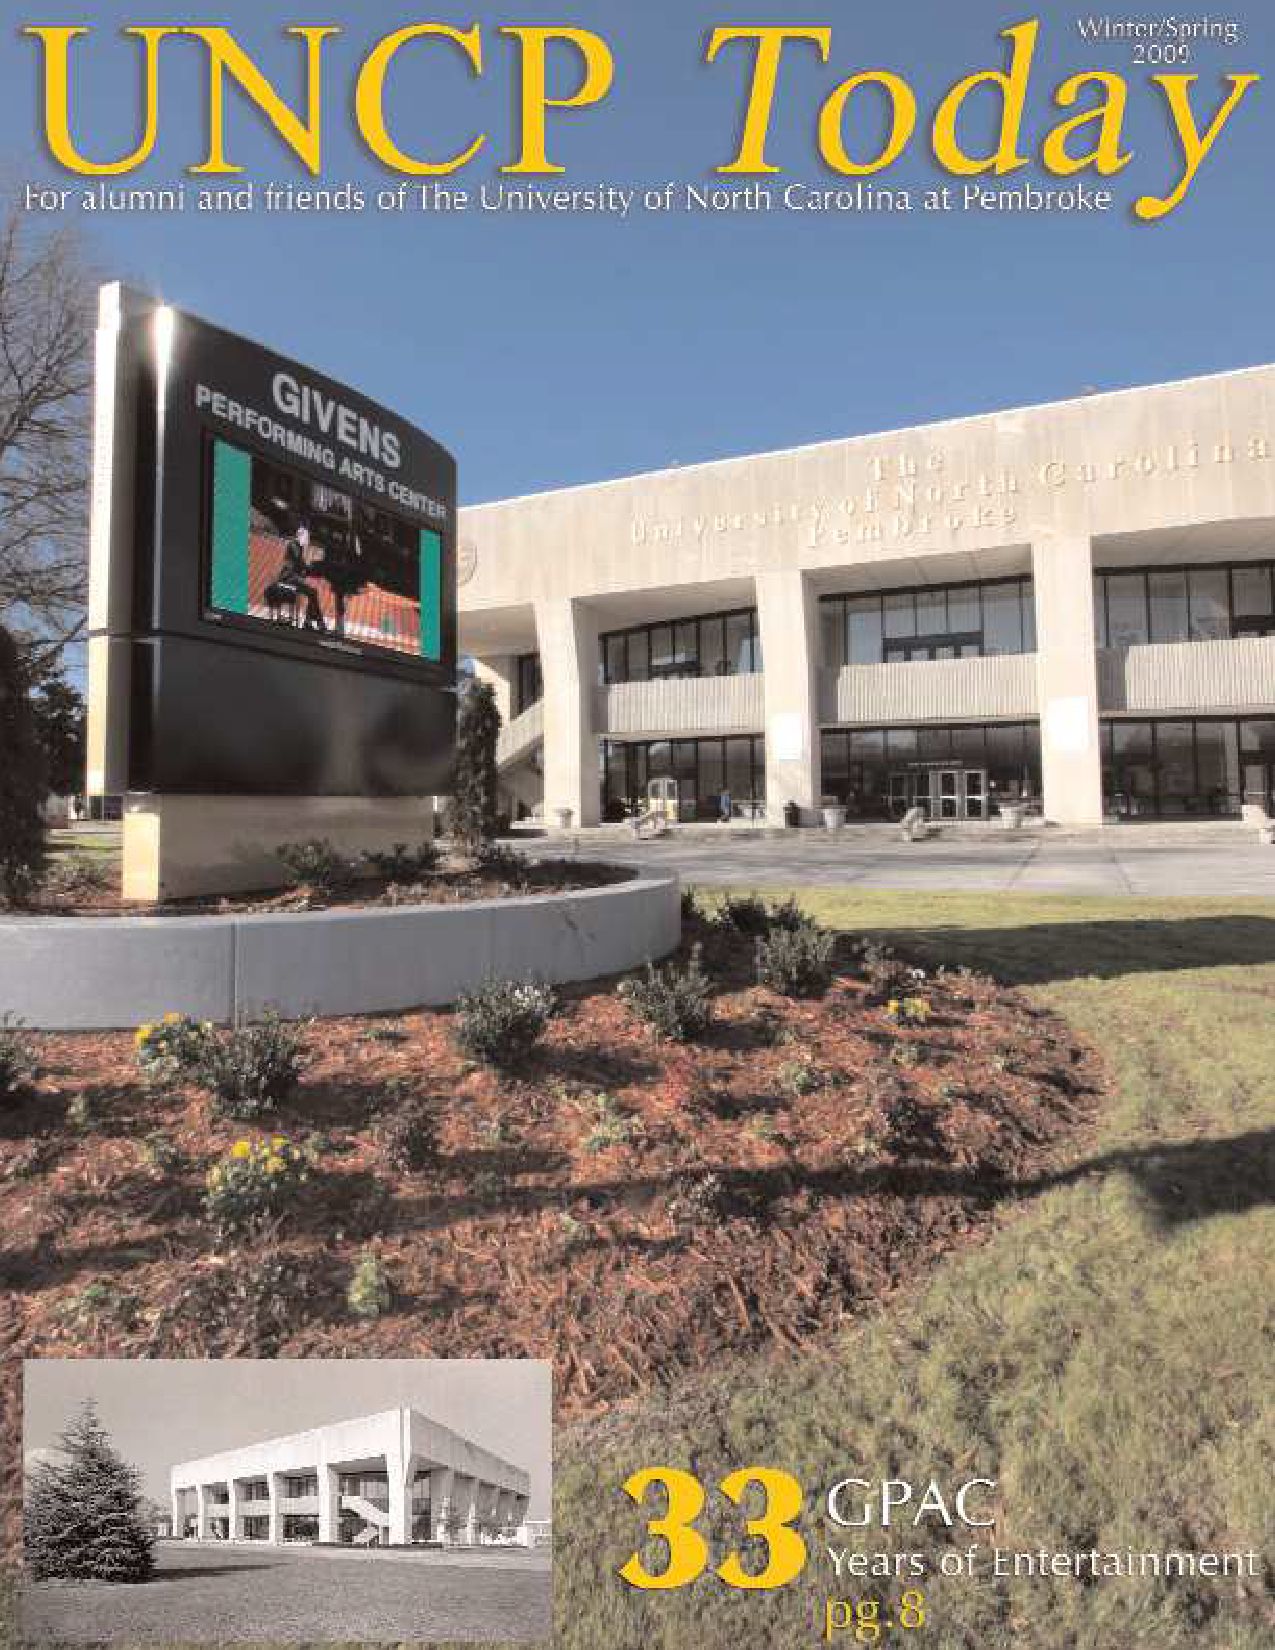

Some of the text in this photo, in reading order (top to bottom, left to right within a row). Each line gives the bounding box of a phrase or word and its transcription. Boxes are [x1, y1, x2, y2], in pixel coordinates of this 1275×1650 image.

[196, 383, 447, 520] PERFORMING ARTS CENTER
[272, 372, 401, 469] GIVENS
